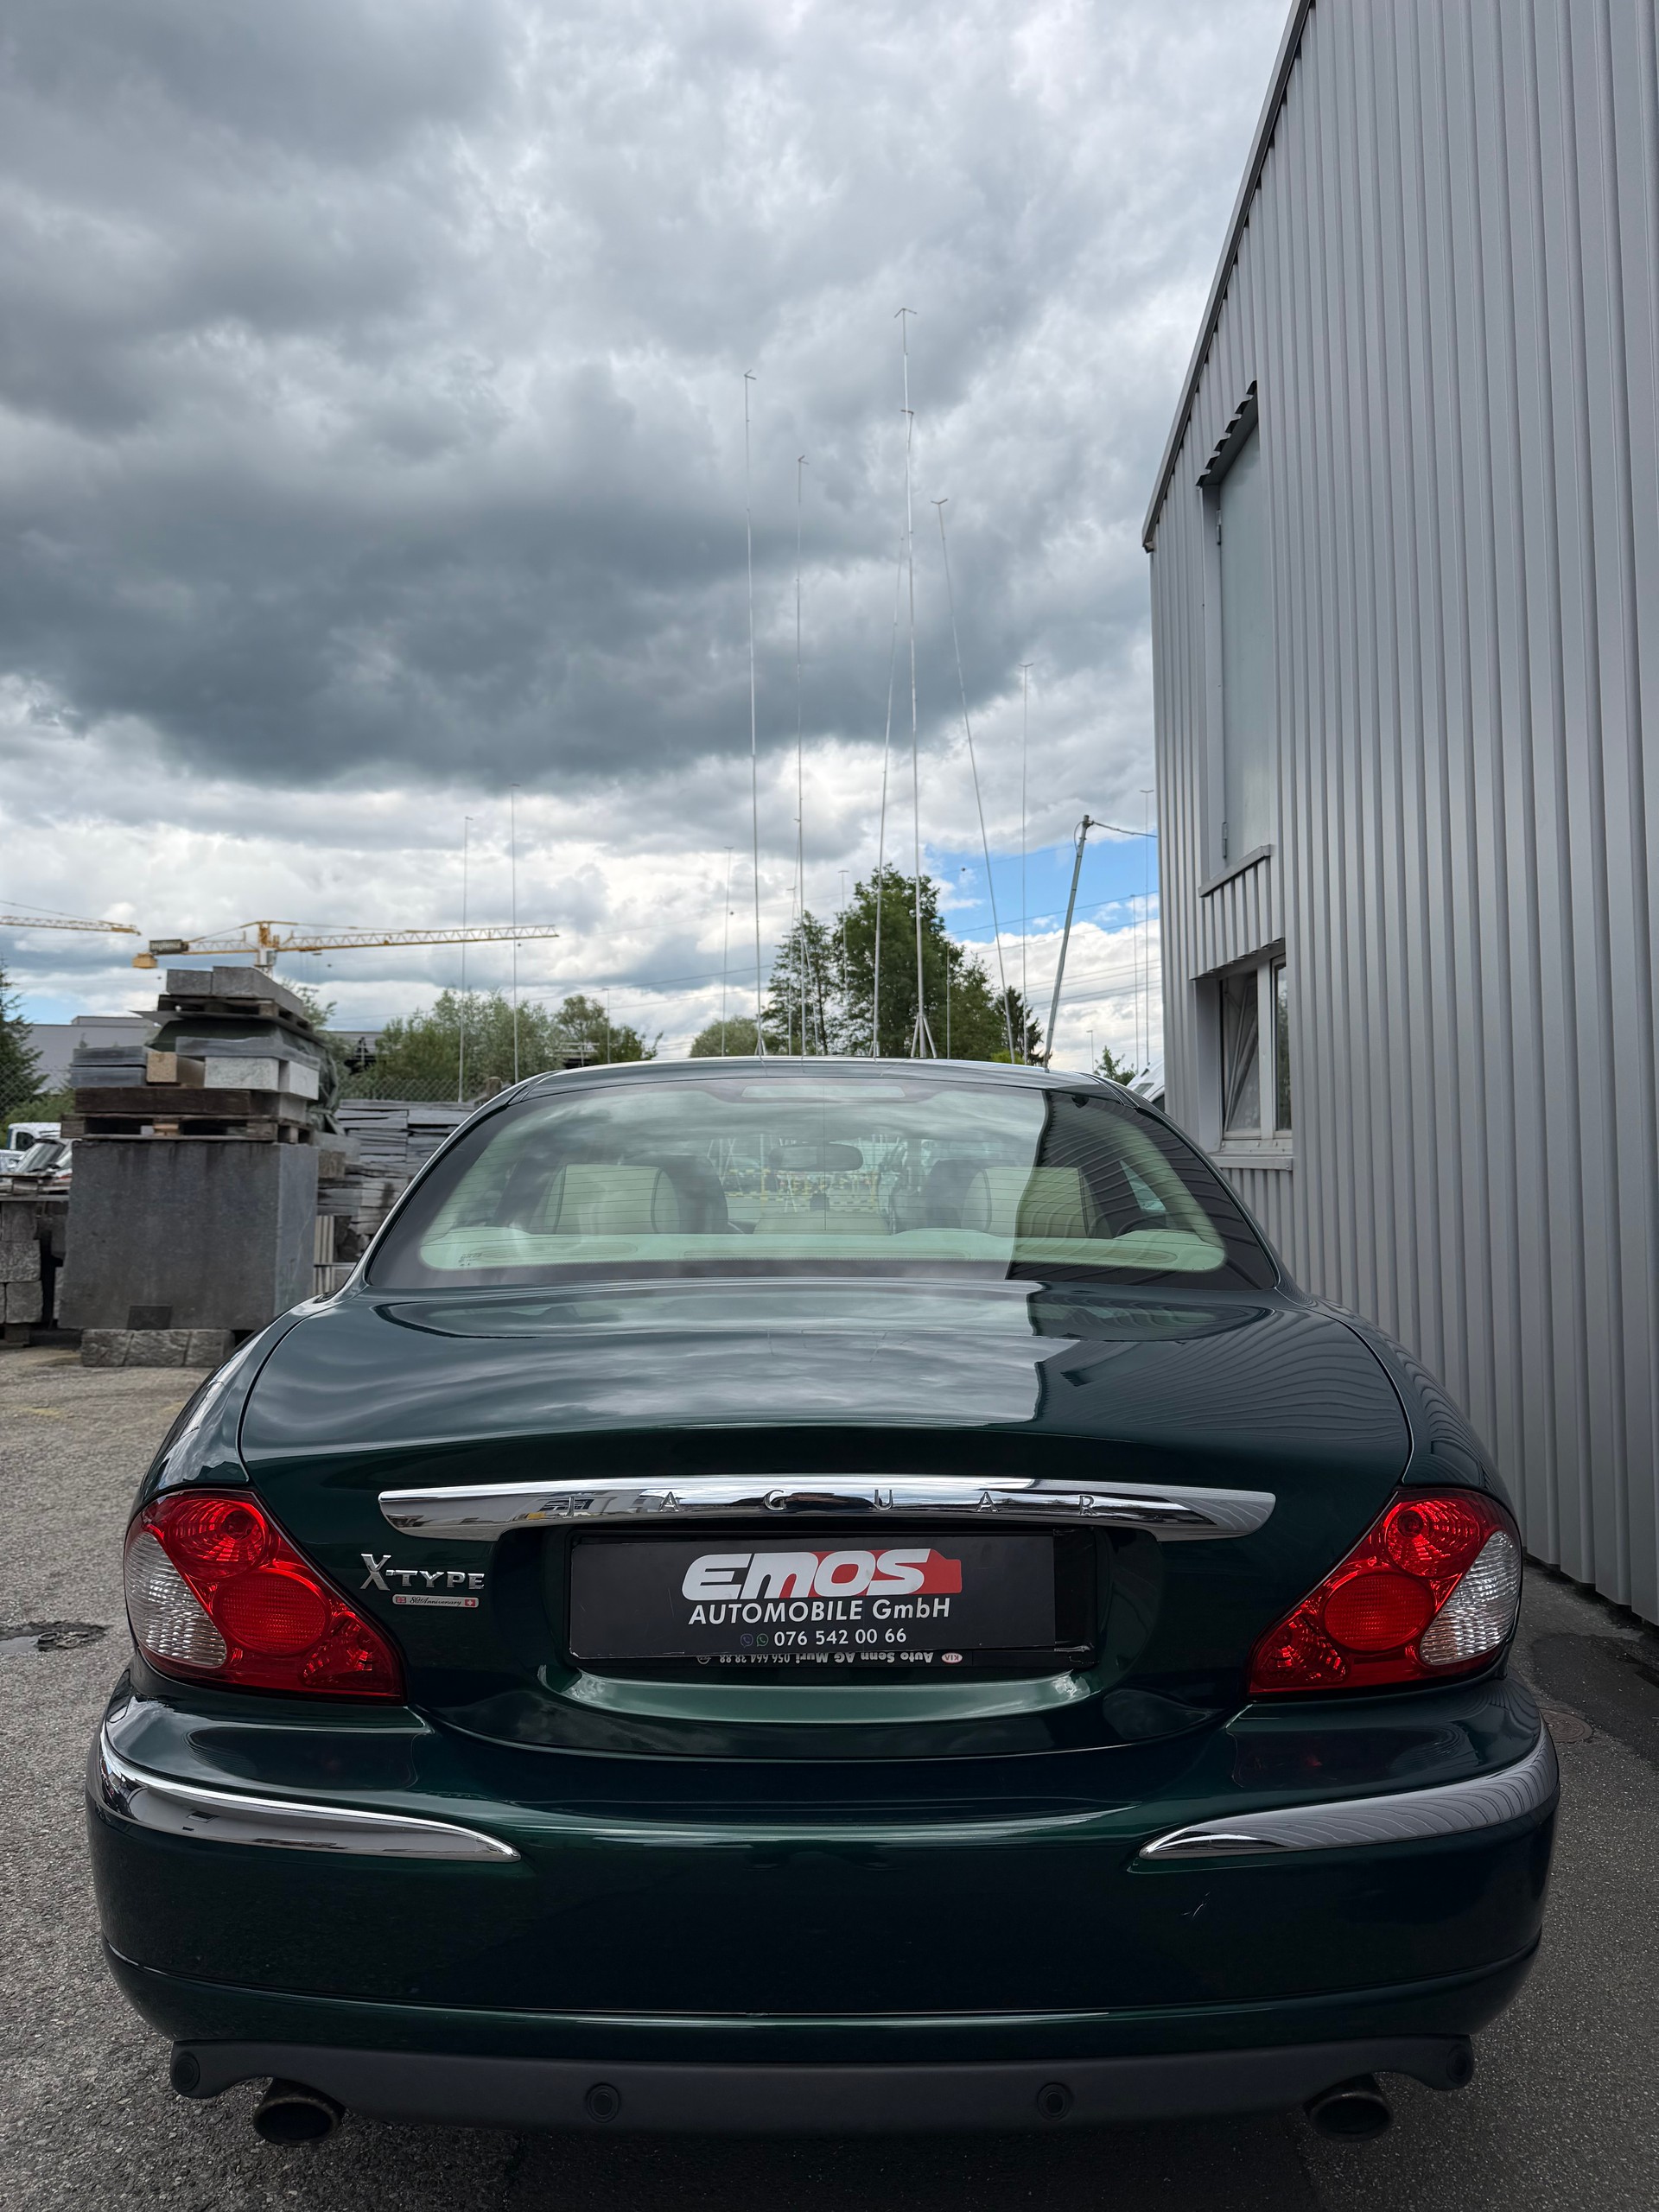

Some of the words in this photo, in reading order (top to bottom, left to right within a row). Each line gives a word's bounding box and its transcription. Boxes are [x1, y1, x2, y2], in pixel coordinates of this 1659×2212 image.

[563, 1489, 1099, 1518] JAGUAR
[688, 1600, 863, 1624] AUTOMOBILE
[872, 1598, 950, 1620] GmbH
[774, 1630, 807, 1646] 076
[816, 1630, 849, 1645] 542
[855, 1629, 878, 1644] 00
[885, 1628, 907, 1643] 66
[795, 1653, 829, 1664] Muri
[834, 1652, 856, 1663] AG
[860, 1652, 895, 1663] Senn
[899, 1652, 934, 1663] Auto
